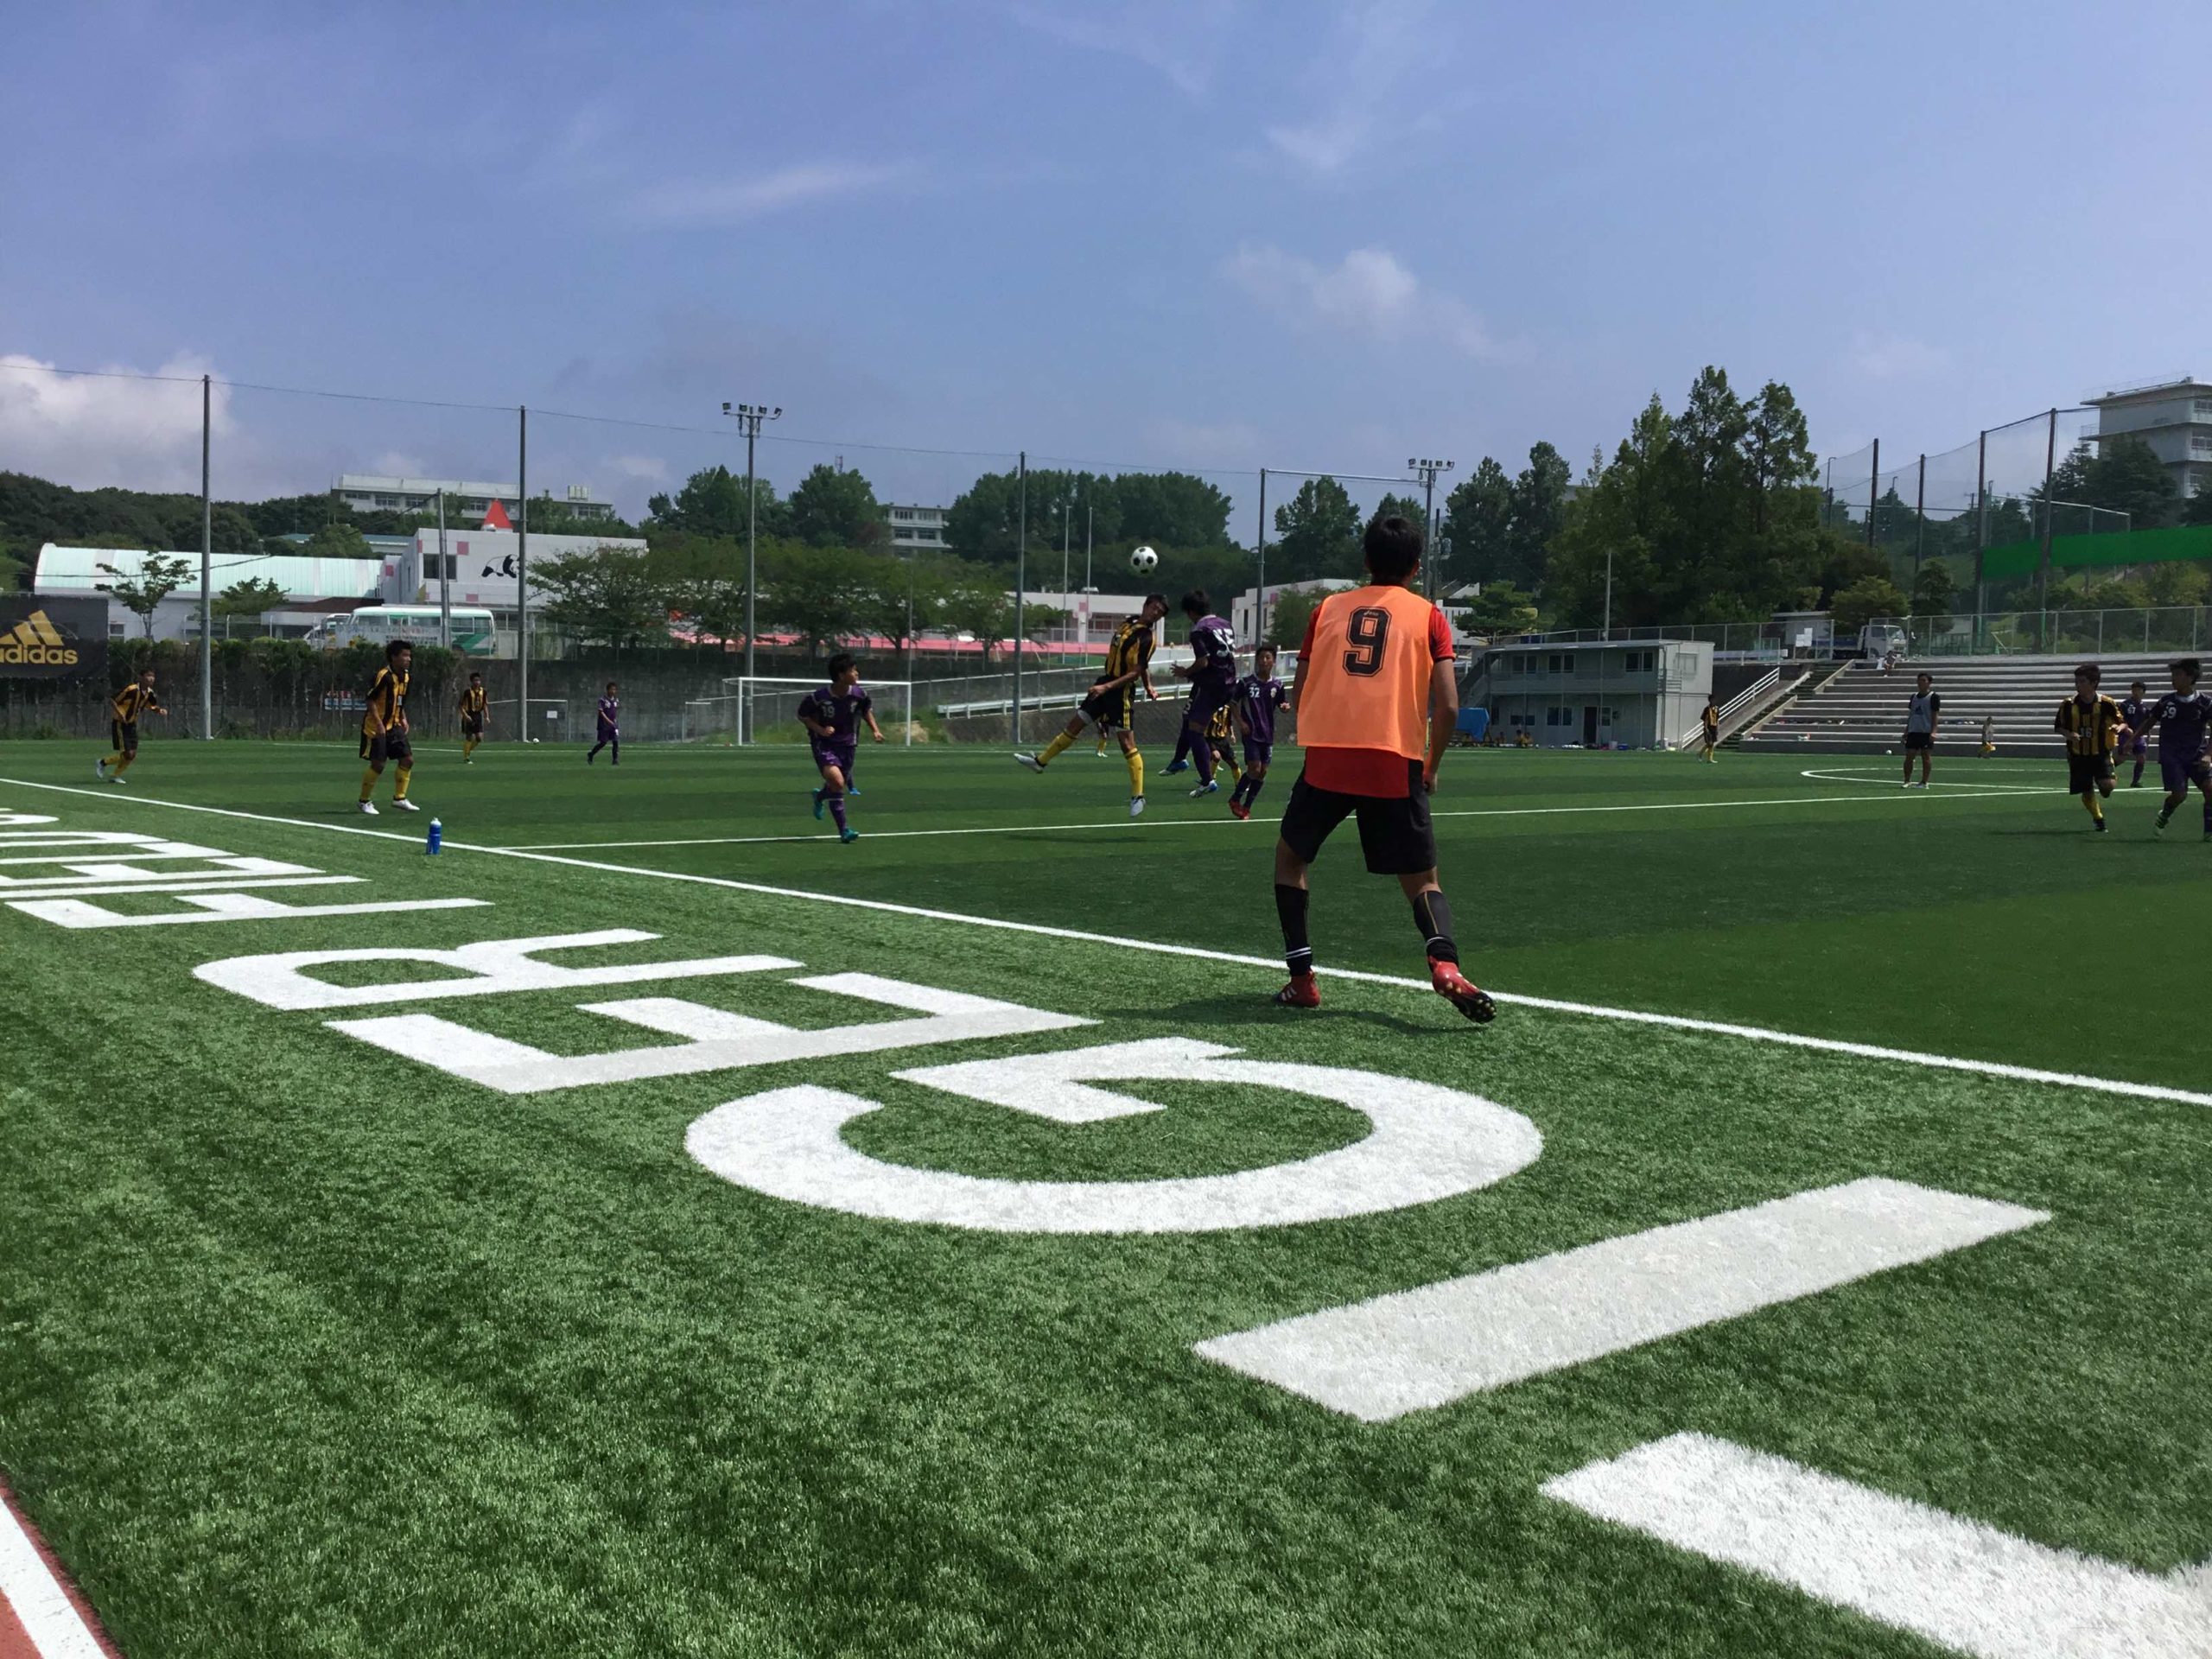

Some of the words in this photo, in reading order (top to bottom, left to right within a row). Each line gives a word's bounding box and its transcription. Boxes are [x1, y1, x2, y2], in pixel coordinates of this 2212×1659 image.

[1343, 606, 1392, 677] 9
[0, 644, 79, 664] didas
[1249, 687, 1261, 698] 32
[822, 705, 835, 718] 19
